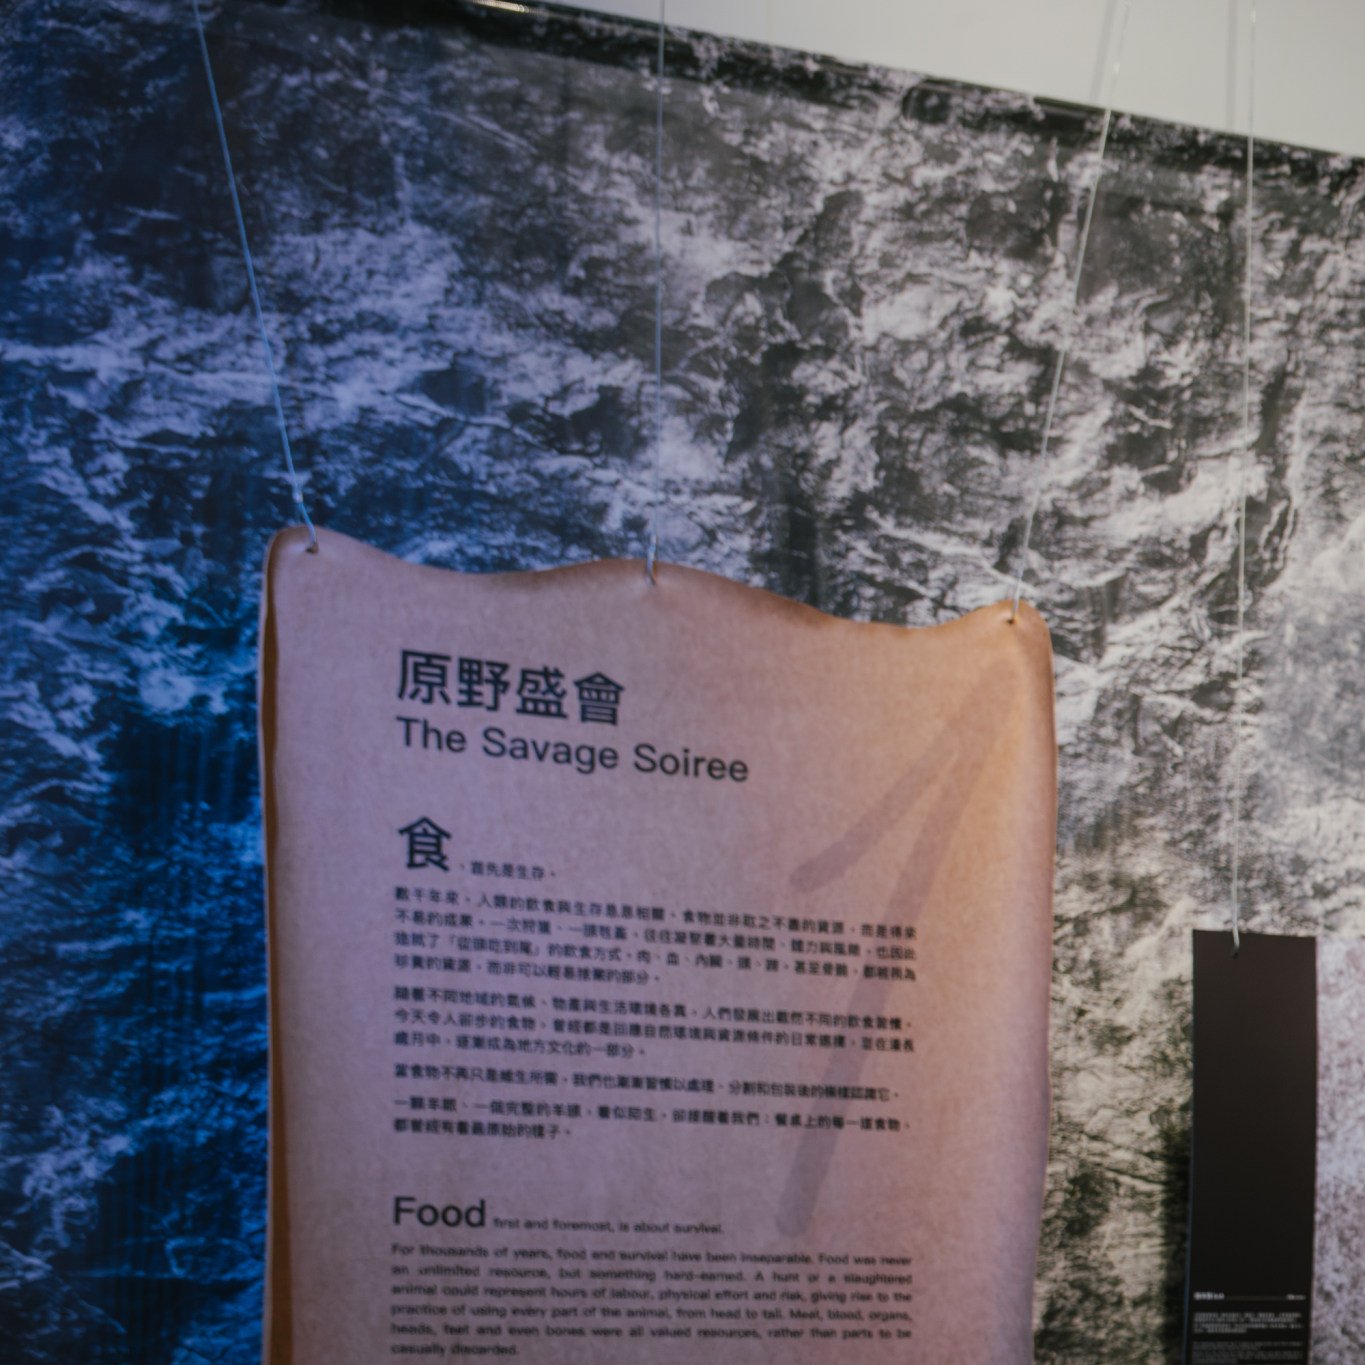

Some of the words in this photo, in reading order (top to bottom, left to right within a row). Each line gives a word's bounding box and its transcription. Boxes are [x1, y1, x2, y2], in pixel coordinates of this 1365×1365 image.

[397, 648, 626, 727] 原野盛會
[395, 715, 467, 754] The
[481, 727, 620, 775] Savage
[633, 743, 750, 783] Soiree
[398, 815, 452, 874] 食
[392, 1195, 487, 1230] Food
